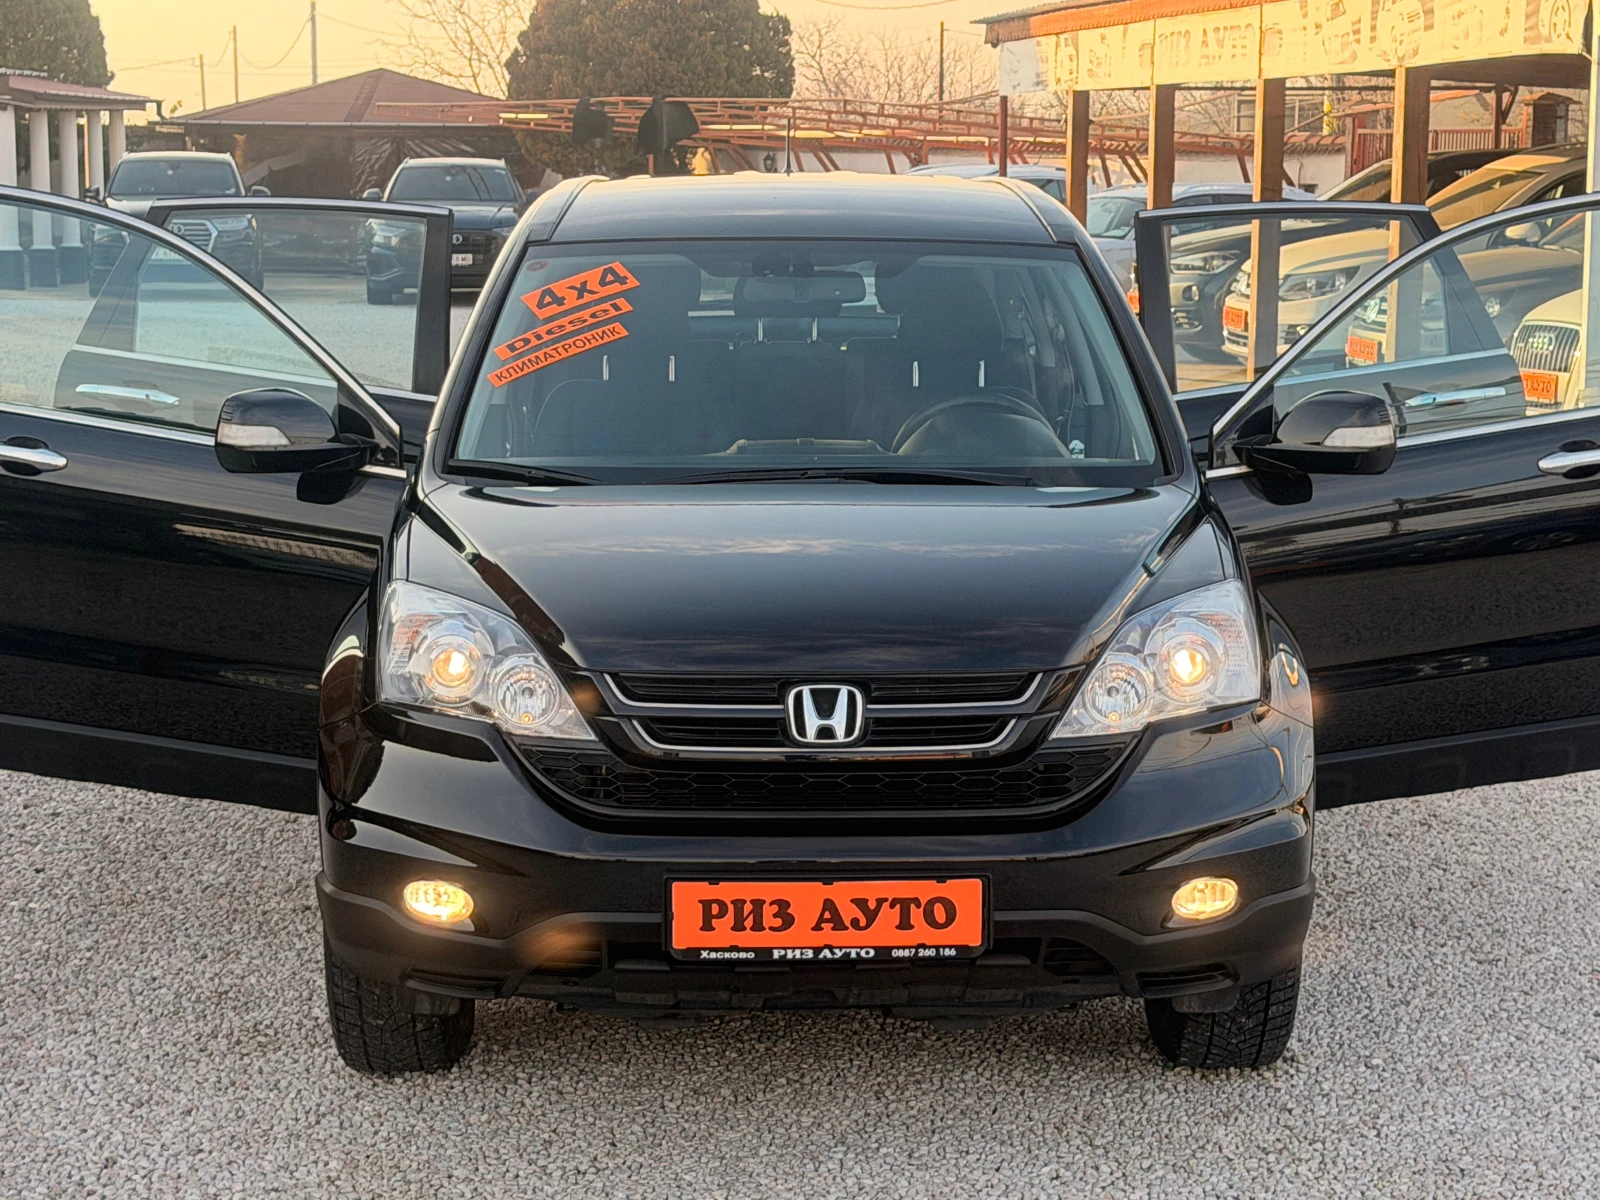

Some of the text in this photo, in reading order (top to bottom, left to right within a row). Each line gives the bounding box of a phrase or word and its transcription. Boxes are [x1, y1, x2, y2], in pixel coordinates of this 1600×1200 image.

[505, 302, 623, 354] Diesel
[495, 326, 622, 382] КЛИМАТРОНИК
[698, 896, 957, 932] РИЗ АУТО
[700, 947, 957, 959] Хасково РИЗ АУТО 0887 260 186
